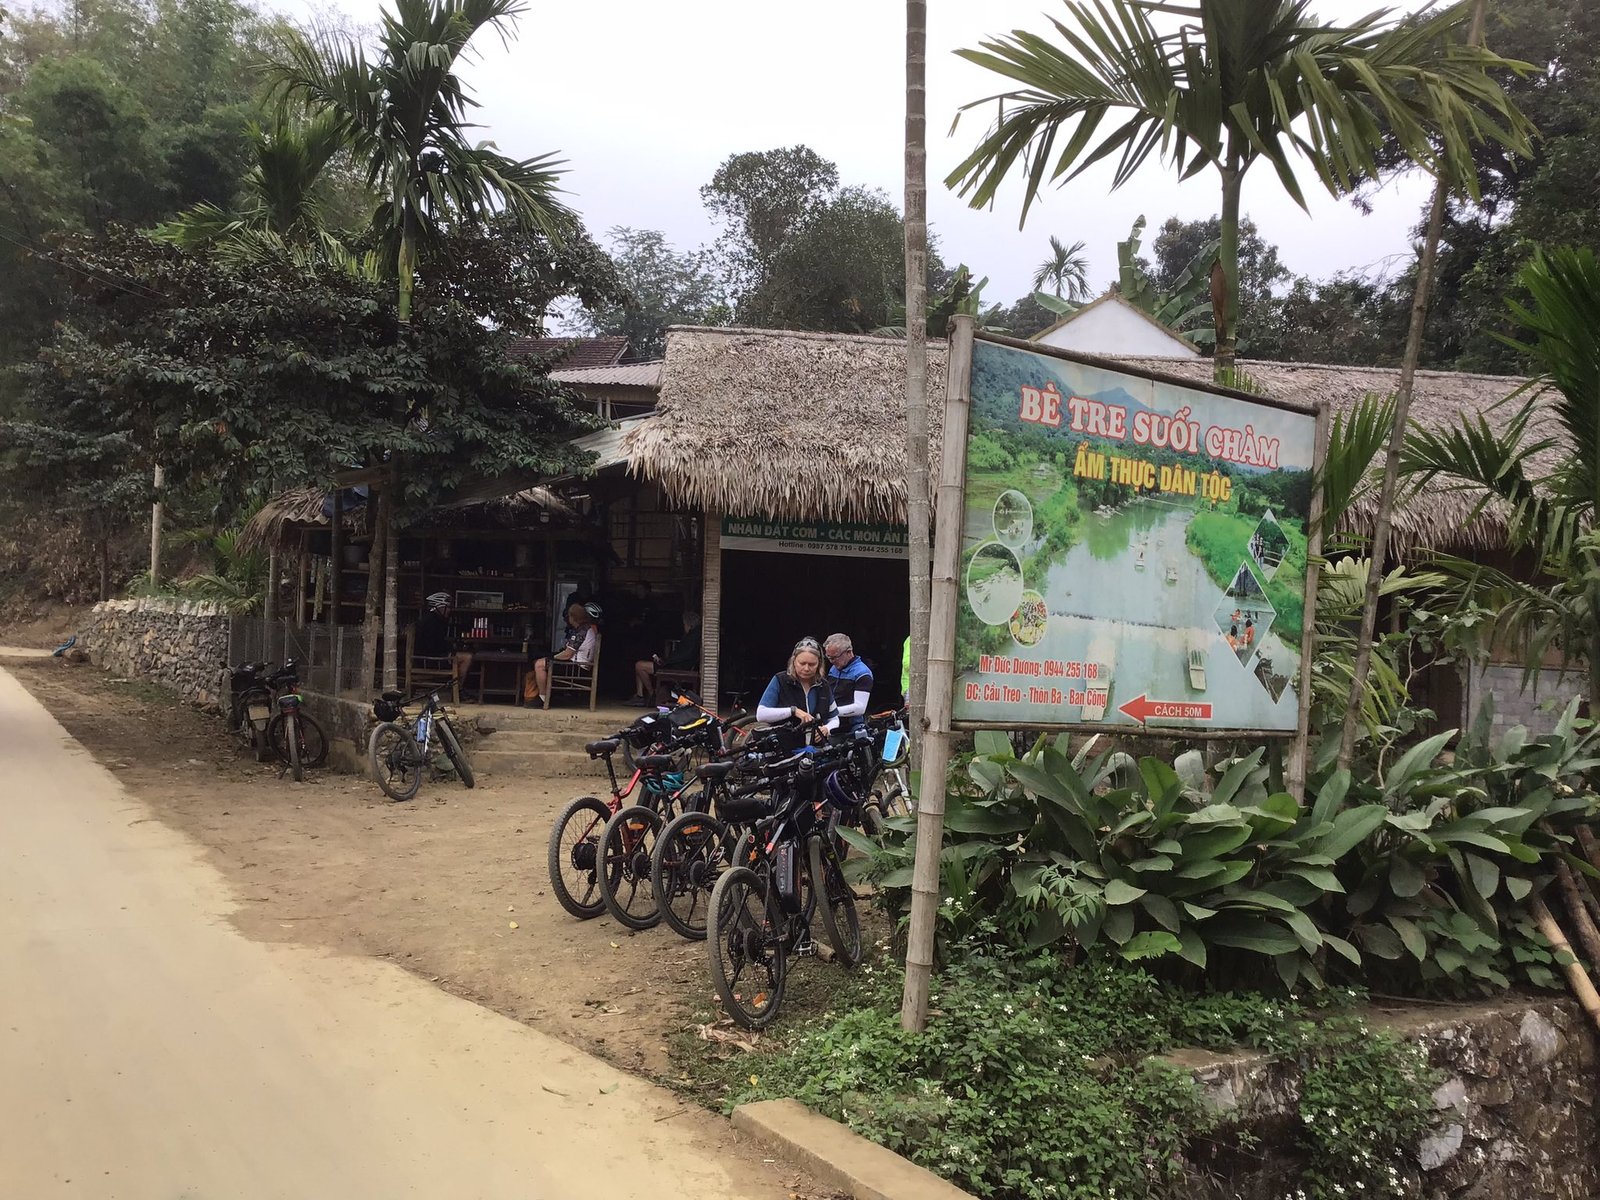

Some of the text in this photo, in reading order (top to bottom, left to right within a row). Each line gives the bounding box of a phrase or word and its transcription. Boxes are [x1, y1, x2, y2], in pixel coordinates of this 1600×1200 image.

[1020, 381, 1280, 469] BÈ TRE SUỐI CHÀM
[1073, 440, 1232, 504] ẨM THỰC DÂN TỘC
[979, 655, 1098, 680] Mr Đức Dương: 0944 255 168
[966, 683, 982, 701] ĐC:
[983, 680, 1000, 702] Cầu
[1002, 685, 1021, 702] Treo
[1029, 686, 1050, 704] Thôn
[1050, 688, 1062, 704] Ba
[1085, 689, 1107, 708] Công
[1154, 704, 1202, 717] CÁCH 50M
